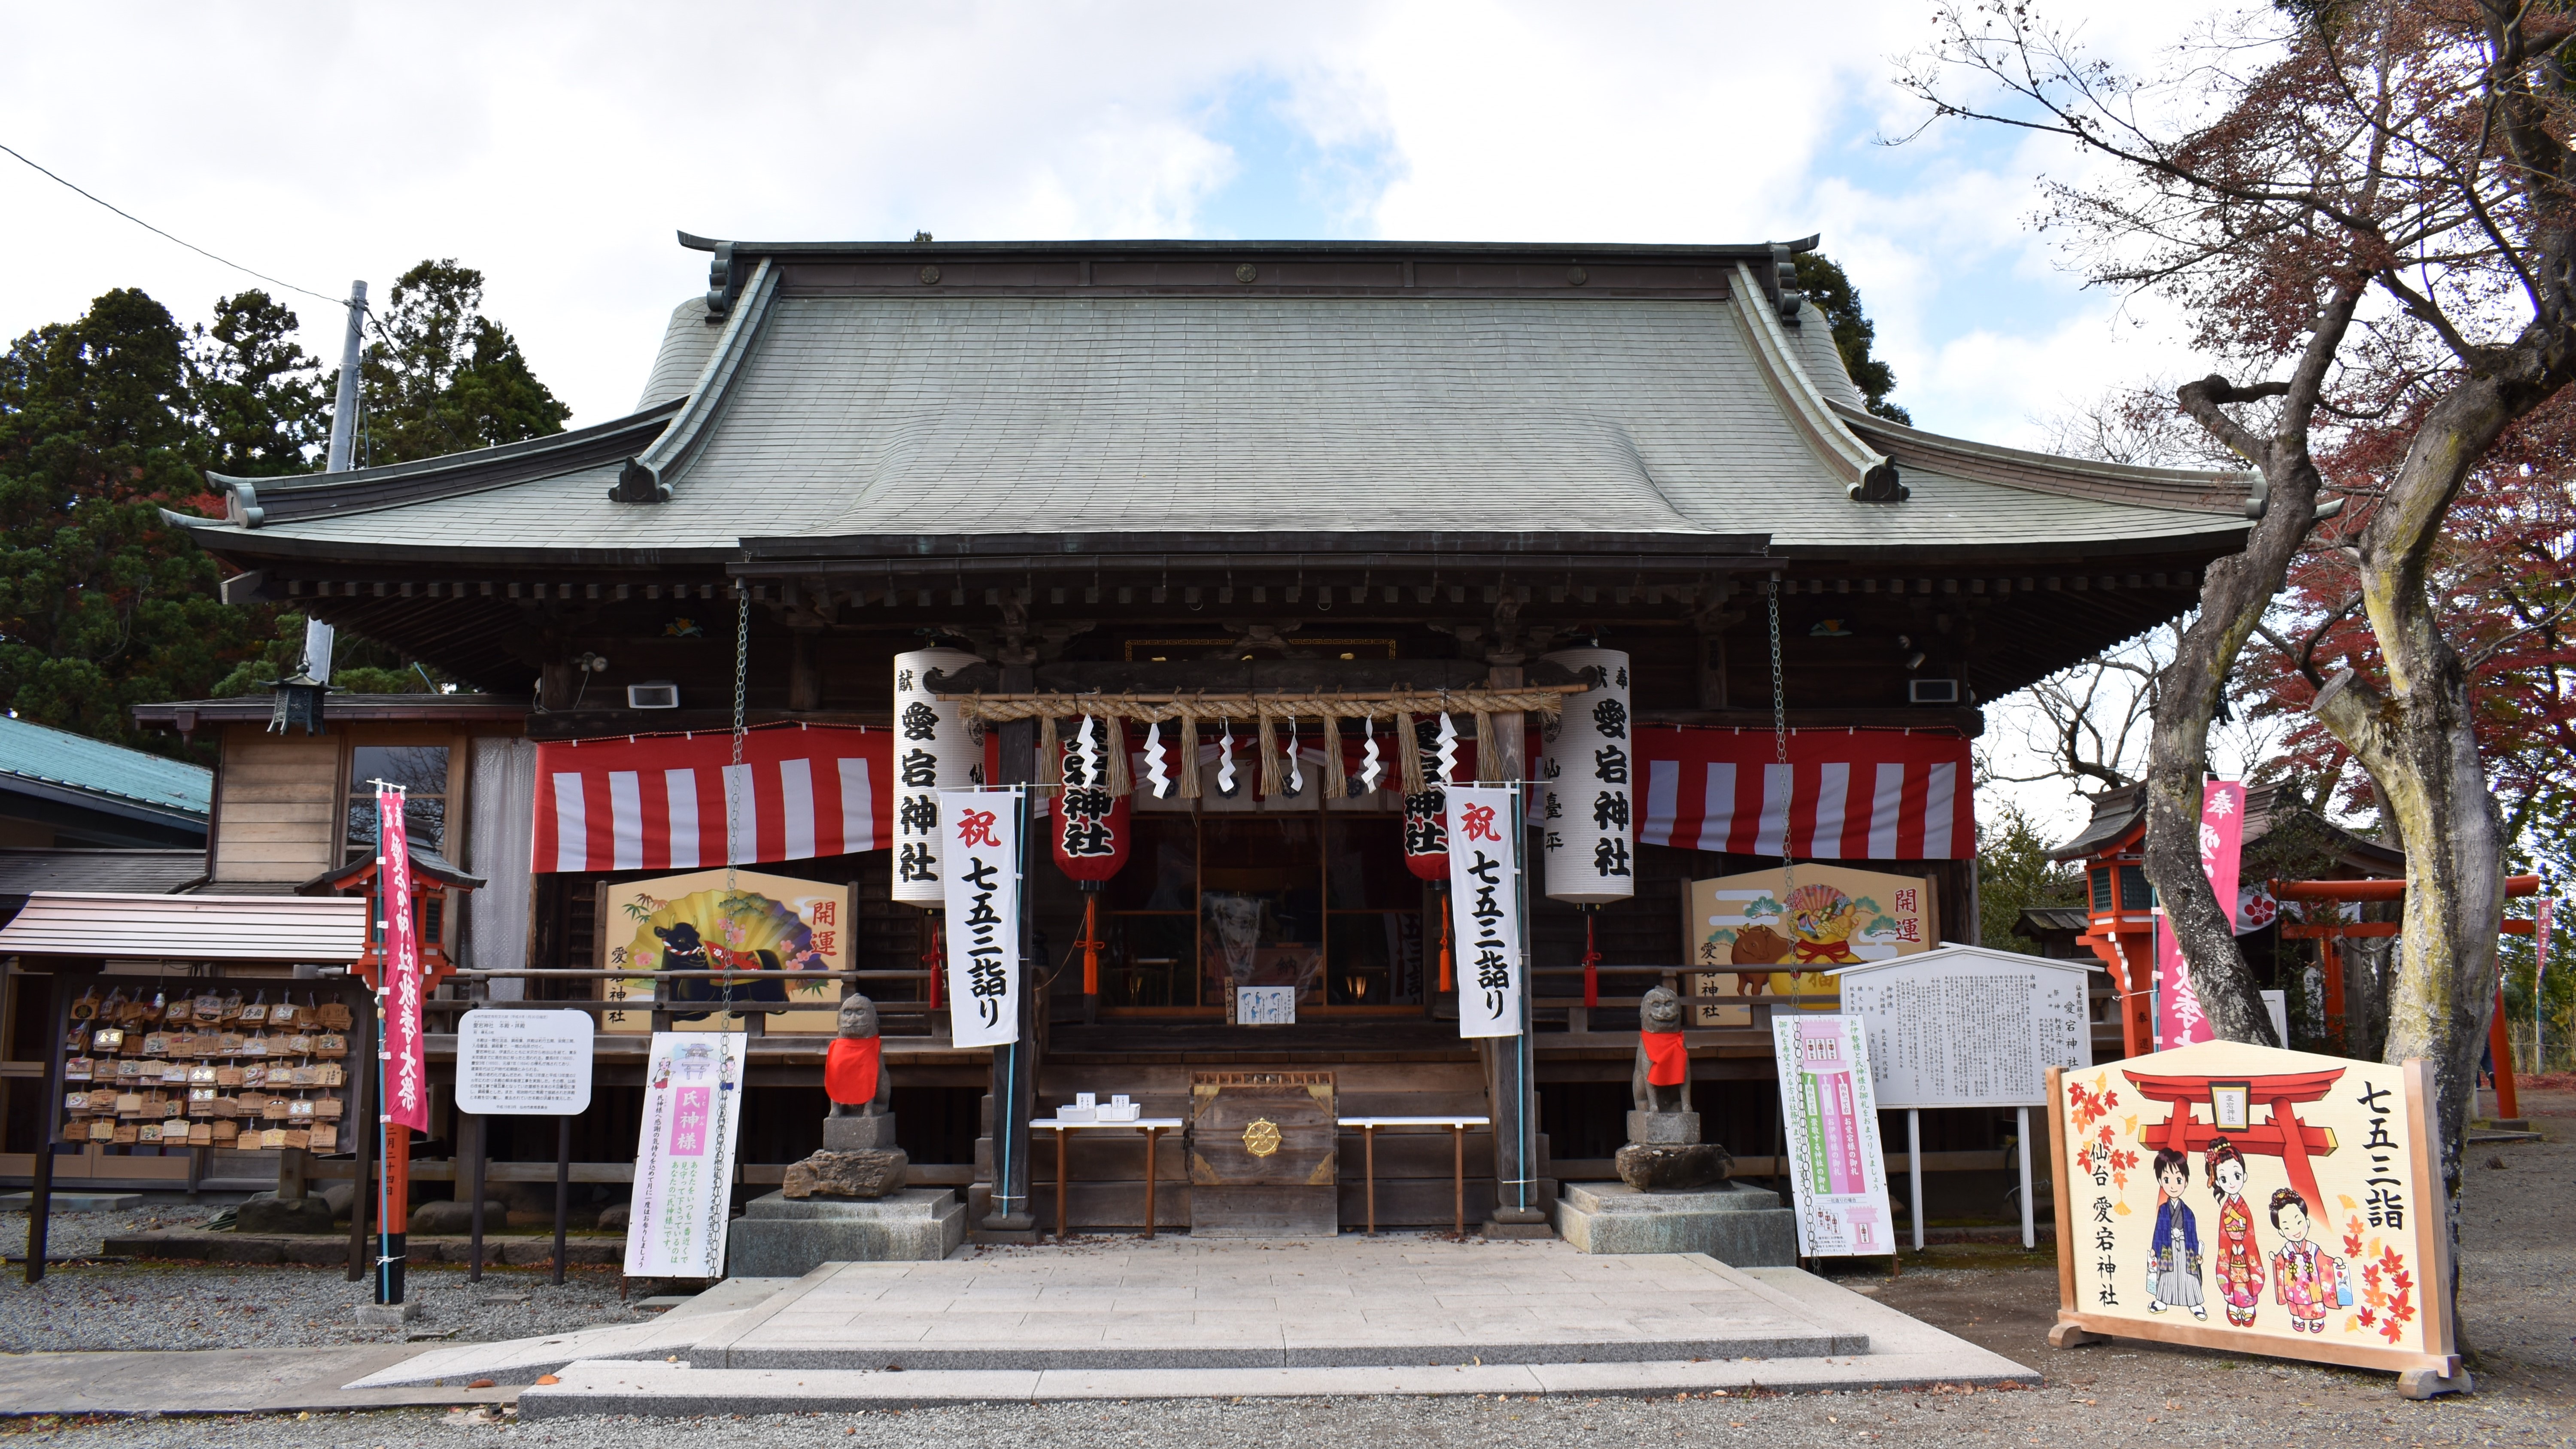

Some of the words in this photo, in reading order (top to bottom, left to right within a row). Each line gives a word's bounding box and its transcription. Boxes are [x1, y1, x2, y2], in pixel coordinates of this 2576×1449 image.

[900, 702, 939, 883] 愛宕神社
[1592, 699, 1631, 877] 愛宕神社
[957, 808, 1002, 849] 祝
[1461, 802, 1502, 842] 祝
[811, 901, 837, 957] 開運
[961, 857, 1006, 1029] 七五三詣り
[1467, 850, 1510, 1021] 七五三詣り
[1894, 887, 1922, 943] 開運
[98, 1032, 120, 1042] 金運
[2064, 1001, 2079, 1068] 愛宕神社
[192, 1069, 214, 1080] 合格
[192, 1089, 214, 1100] 金運
[1807, 1086, 1816, 1114] 向かって左
[1840, 1086, 1849, 1113] 向かって右
[289, 1103, 312, 1114] 金運
[677, 1090, 700, 1150] 氏神様
[1850, 1020, 1879, 1192] お伊勢様と氏神様の御札をおまつりしましょう
[2226, 1095, 2236, 1122] 愛宕神社
[2089, 1143, 2110, 1187] 仙台
[2357, 1081, 2404, 1231] 七五三詣
[671, 1161, 688, 1264] 見守って下さっているのは
[681, 1161, 698, 1264] あなたをいつも一番近くで
[2093, 1196, 2119, 1308] 愛宕神社
